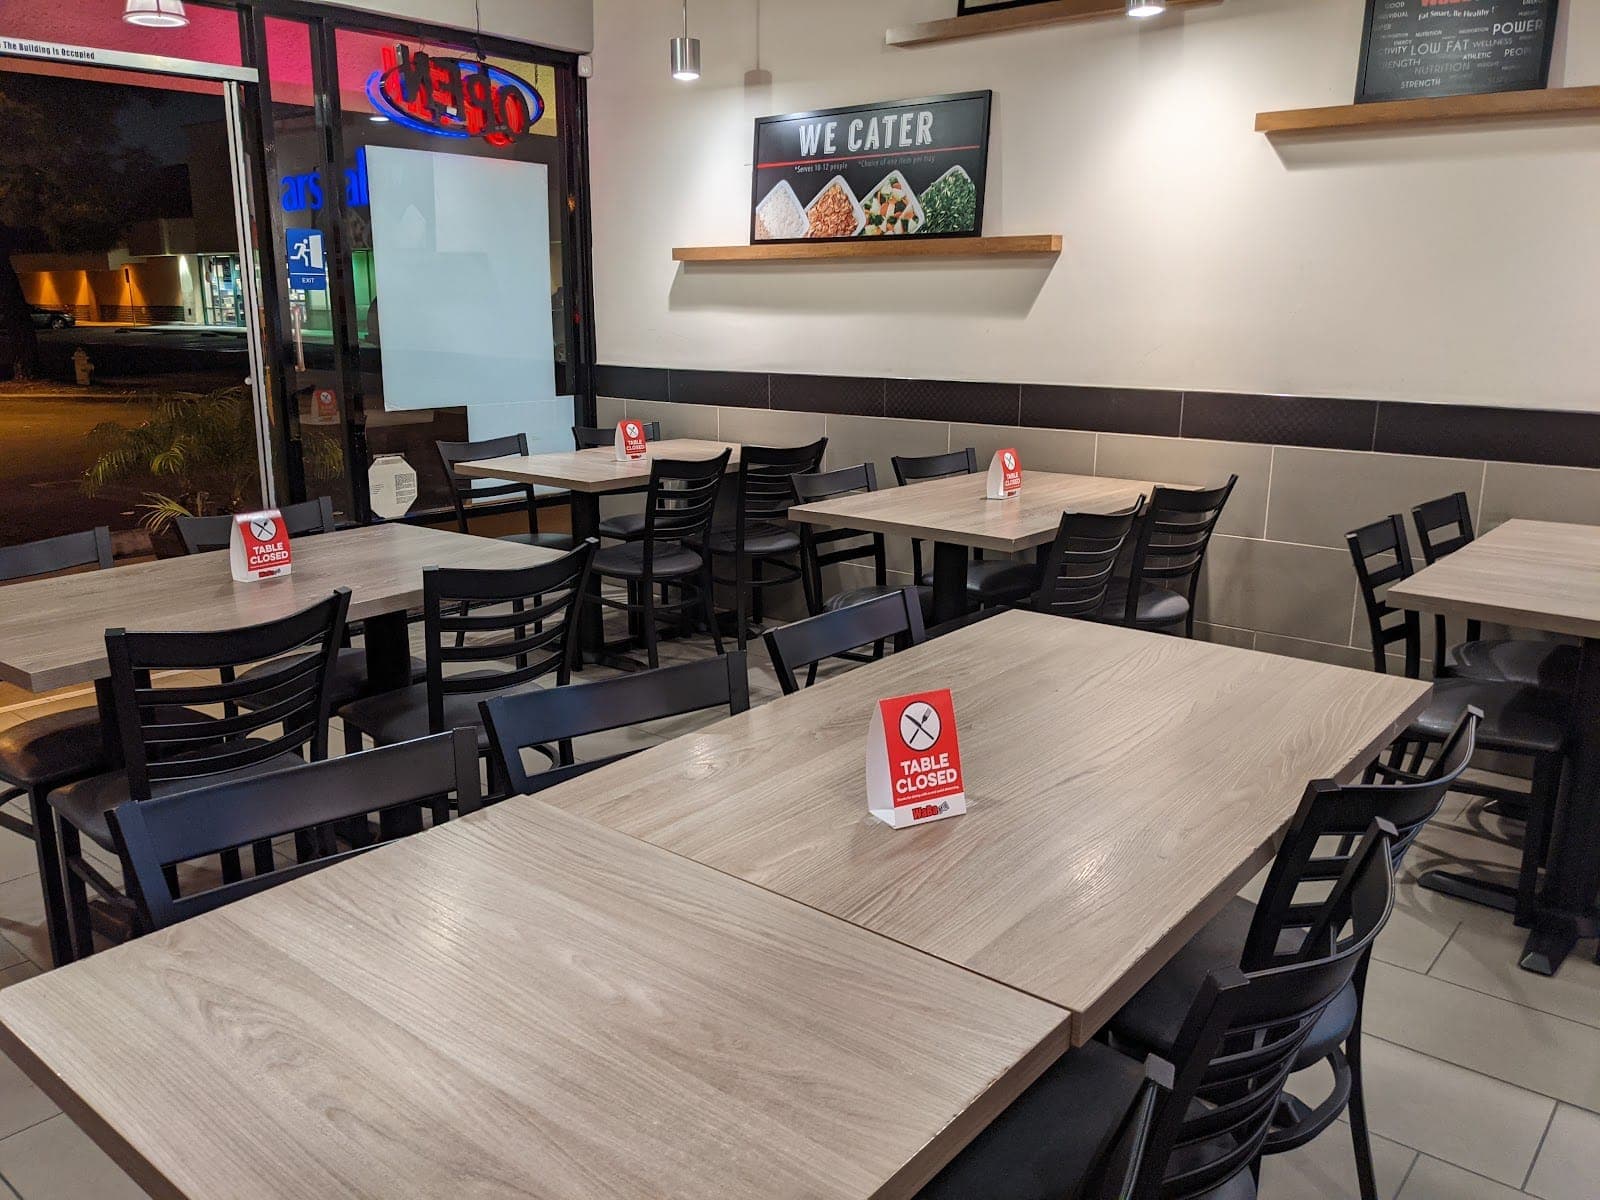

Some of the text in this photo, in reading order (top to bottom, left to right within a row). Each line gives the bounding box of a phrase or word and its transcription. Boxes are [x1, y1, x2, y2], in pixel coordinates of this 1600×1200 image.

[1492, 19, 1543, 36] POWER
[3, 41, 95, 60] The Building Is Occupied
[1410, 39, 1469, 56] LOW FAT
[1462, 51, 1493, 61] ATHLETIC
[1414, 62, 1470, 75] NUTRITION
[1400, 78, 1441, 89] STRENGTH
[799, 111, 934, 157] WE CATER
[252, 542, 283, 555] TABLE
[250, 551, 288, 565] CLOSED
[900, 753, 949, 776] TABLE
[896, 768, 958, 794] CLOSED
